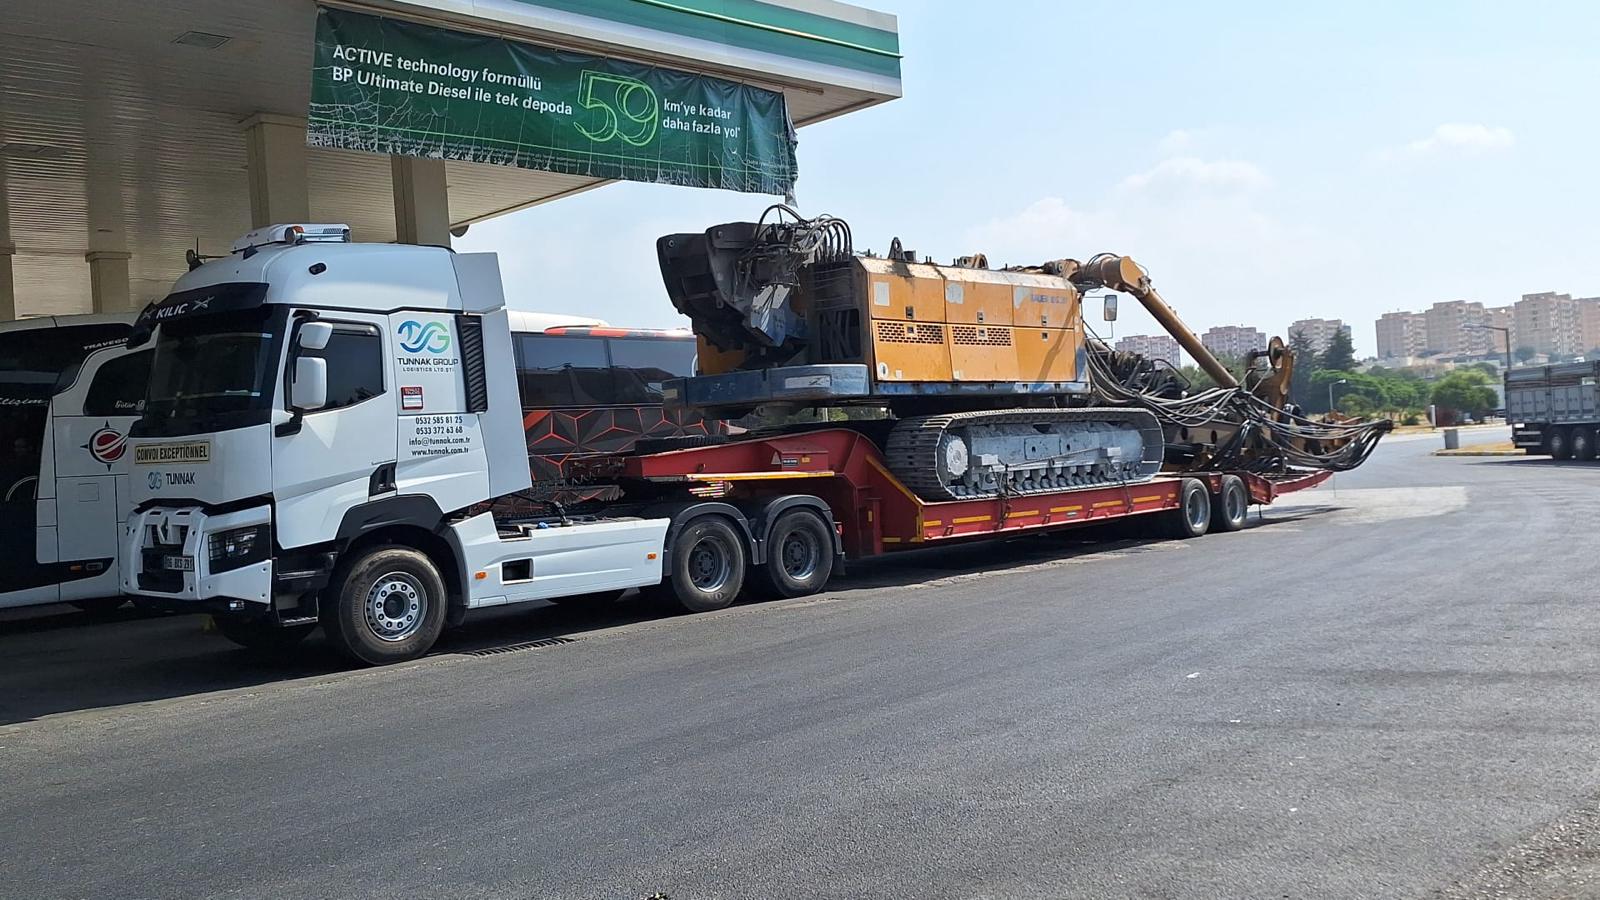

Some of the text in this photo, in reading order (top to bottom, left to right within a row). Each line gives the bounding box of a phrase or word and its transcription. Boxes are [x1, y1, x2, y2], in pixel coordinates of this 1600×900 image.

[333, 45, 542, 91] ACTIVE technology formüllü
[333, 66, 573, 116] BP Ultimate Diesel ile tek depoda
[574, 69, 659, 147] 59
[699, 103, 732, 120] kadar
[662, 116, 690, 132] daha
[692, 119, 721, 135] fazla
[83, 337, 129, 350] TRAVEGO
[397, 357, 458, 366] TUNNAK GROUP
[415, 415, 463, 425] 0532 585 81 25
[416, 427, 432, 435] 0533
[433, 427, 445, 435] 372
[409, 436, 470, 446] info@tunnak.com.tr
[136, 445, 208, 461] CONVOI EXCEPTIONNEL
[411, 446, 469, 456] www.tunnak.com.tr
[165, 472, 196, 485] TUNNAK
